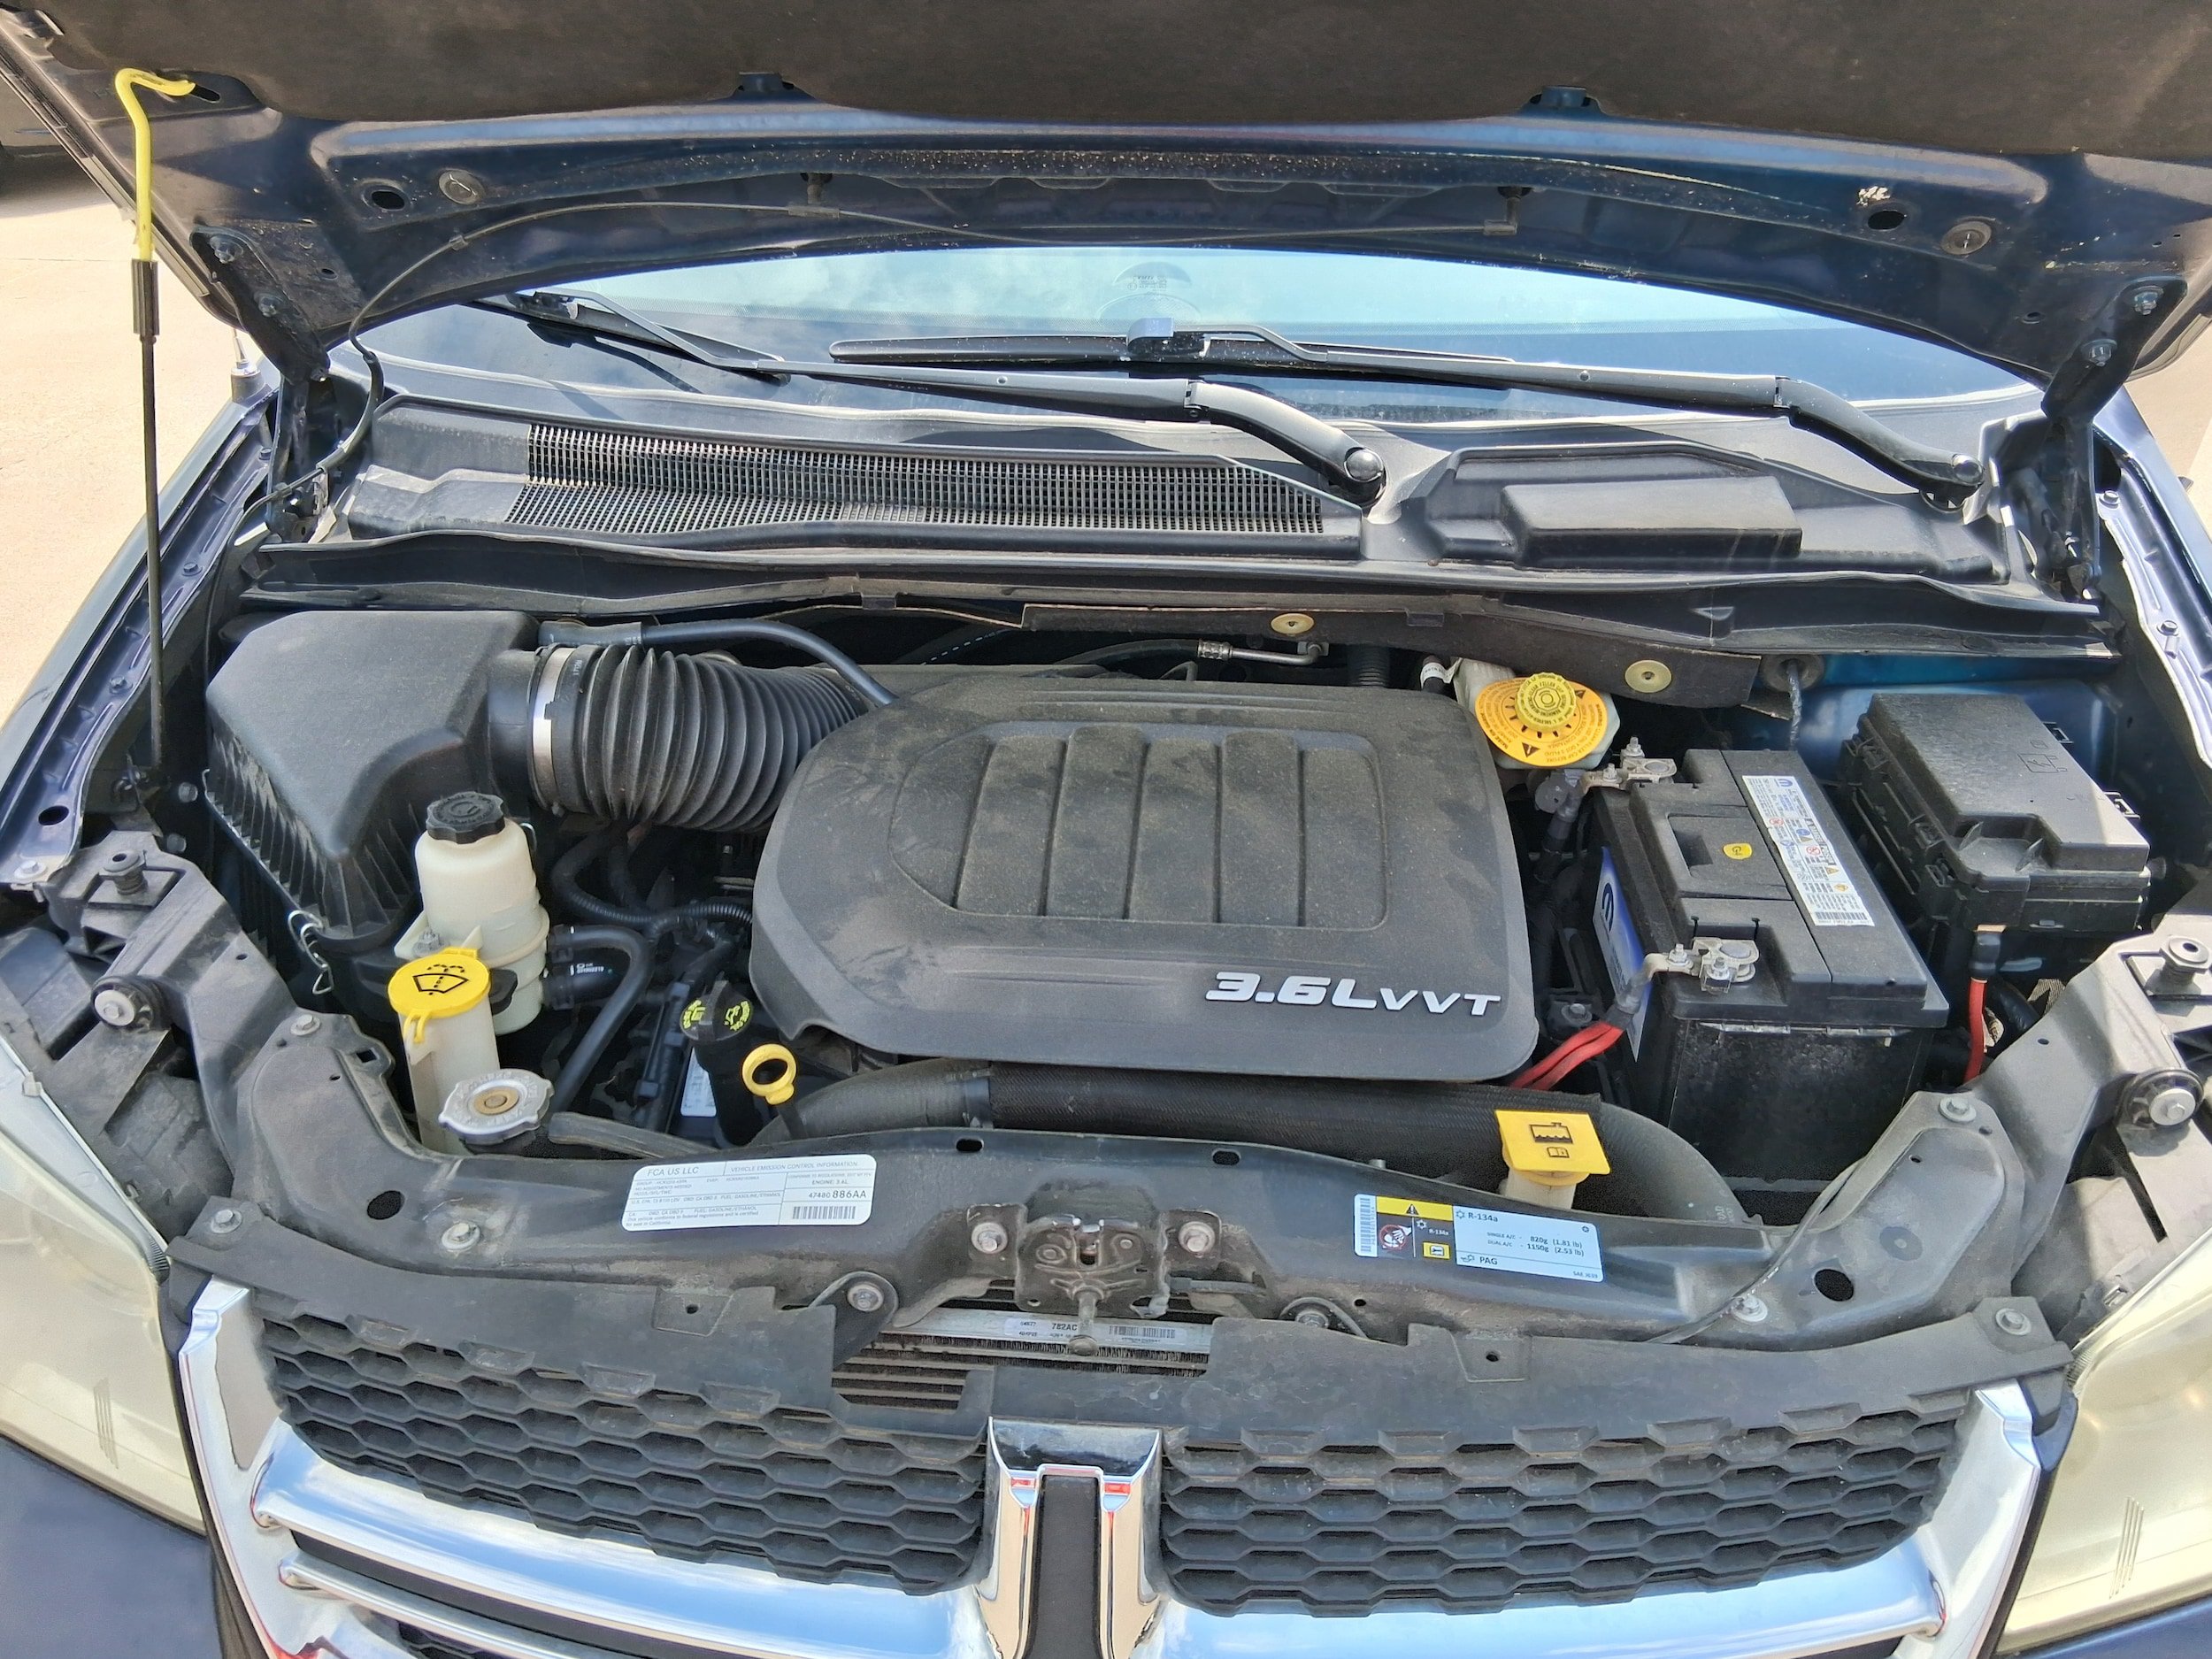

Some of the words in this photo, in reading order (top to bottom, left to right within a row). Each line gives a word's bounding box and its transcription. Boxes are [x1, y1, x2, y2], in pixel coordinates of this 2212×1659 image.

[1206, 972, 1378, 1010] 3.6L
[1379, 987, 1502, 1016] VVT
[647, 1167, 665, 1177] FCA
[682, 1166, 700, 1175] LLC
[832, 1189, 867, 1199] 886AA
[1468, 1211, 1499, 1222] R-134a
[1530, 1236, 1548, 1245] 820g
[1527, 1243, 1549, 1252] 1150g
[1479, 1256, 1498, 1265] PAG
